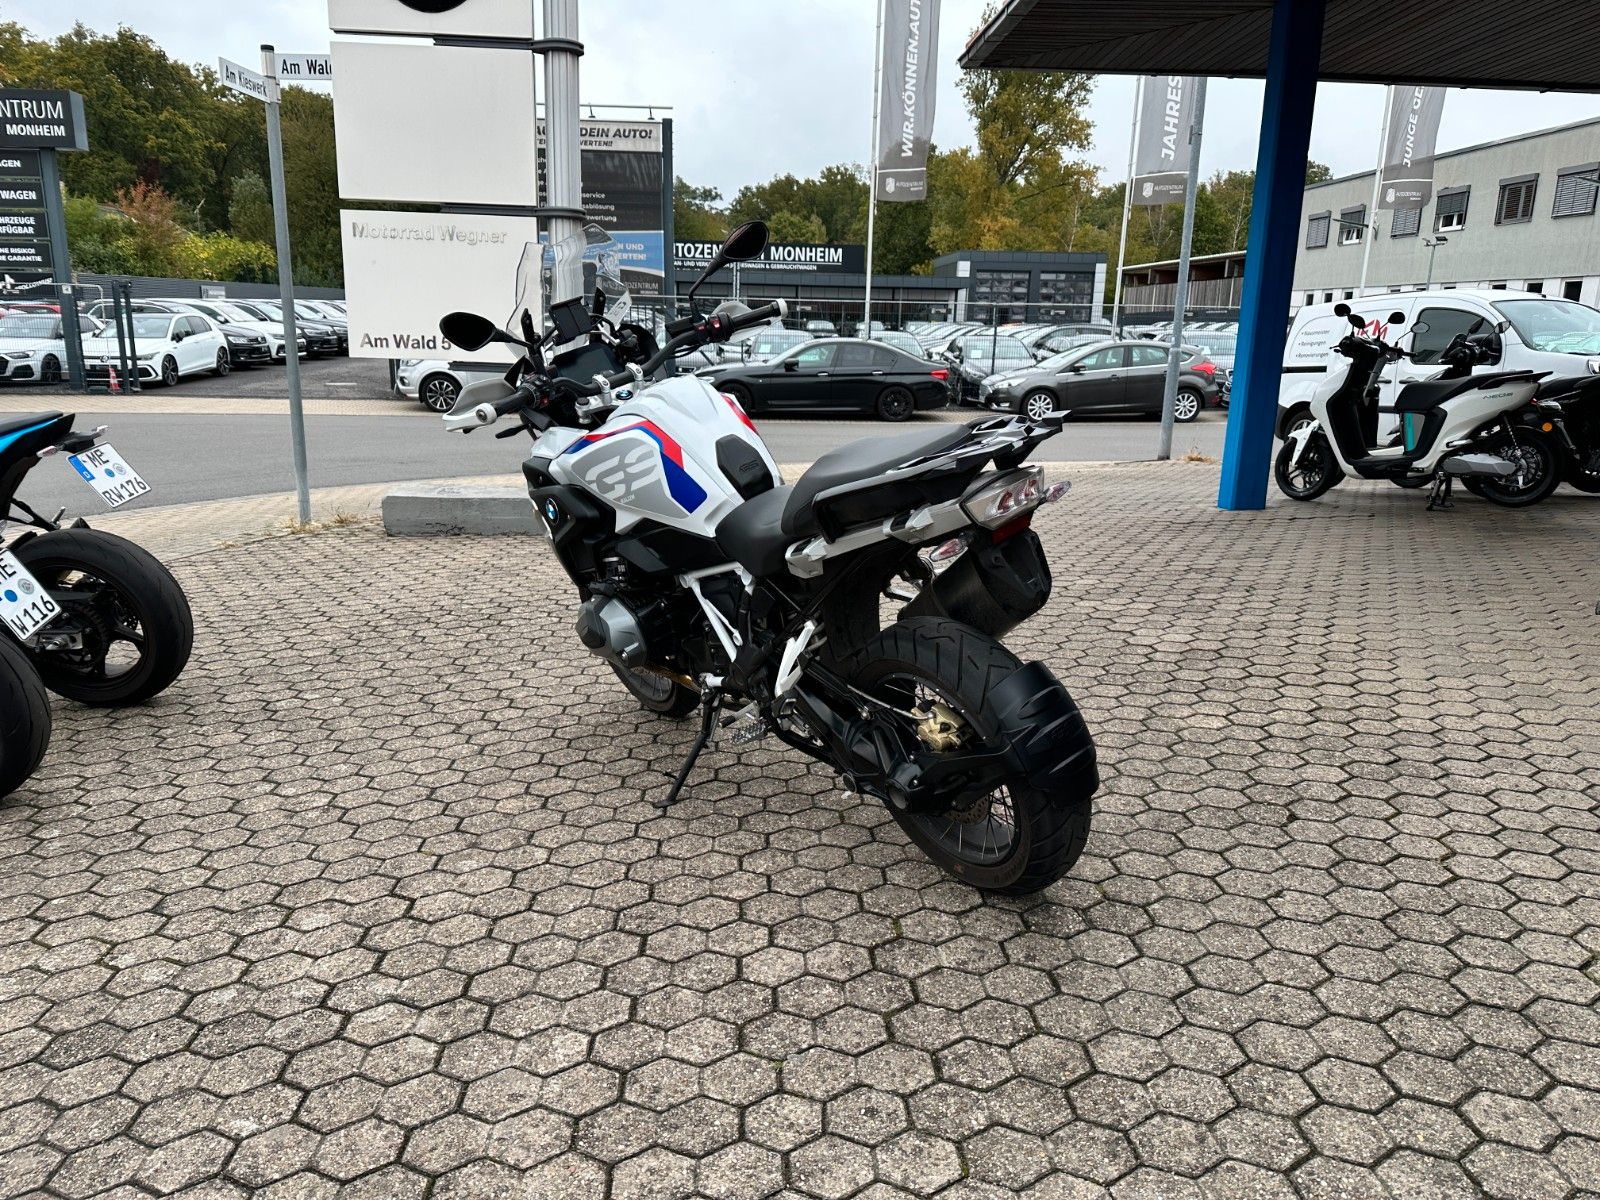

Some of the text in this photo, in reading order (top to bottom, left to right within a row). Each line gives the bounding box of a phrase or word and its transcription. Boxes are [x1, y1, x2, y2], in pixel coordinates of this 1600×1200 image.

[282, 59, 332, 75] Am Wal
[225, 65, 268, 97] Am Kieswerk
[1161, 76, 1183, 161] JAHRES
[5, 124, 66, 137] MONHEIM
[580, 127, 653, 139] DEIN AUTO!
[1402, 113, 1419, 168] JUNGE
[0, 190, 37, 200] WAGEN
[352, 222, 508, 245] Motorrad Wegner
[770, 245, 843, 263] MONHEIM
[771, 263, 817, 271] GEBRAUCHTWAGEN
[360, 333, 452, 350] Am Wald 5
[85, 449, 109, 468] ME
